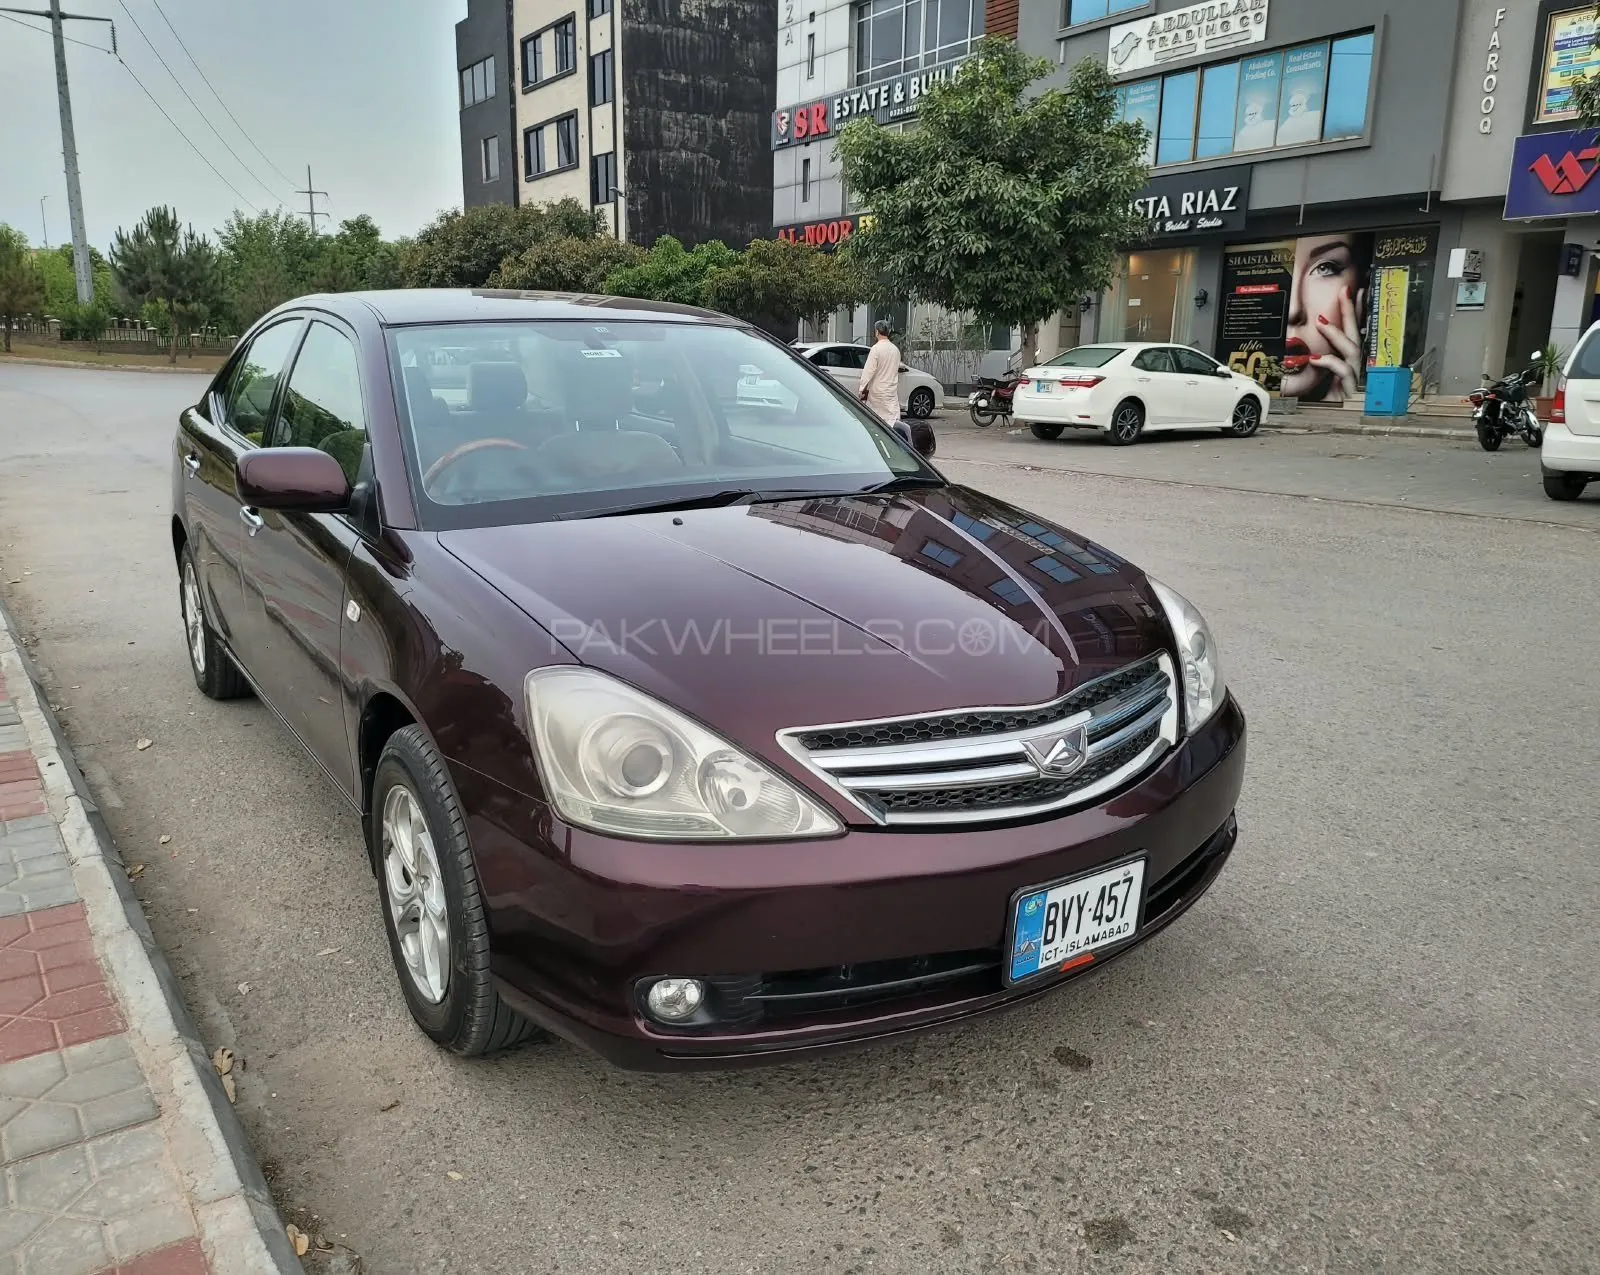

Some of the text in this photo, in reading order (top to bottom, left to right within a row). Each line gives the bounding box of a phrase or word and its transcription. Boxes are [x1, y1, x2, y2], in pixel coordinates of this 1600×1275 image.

[1147, 11, 1265, 50] TRADING CO
[1286, 60, 1322, 73] Consultants
[1303, 50, 1322, 60] Estate
[1479, 8, 1505, 134] FAROOQ
[793, 102, 830, 139] SR
[833, 85, 889, 119] ESTATE
[893, 82, 905, 103] &
[1181, 186, 1239, 215] RIAZ
[1164, 220, 1190, 232] Bridal
[1196, 217, 1223, 228] Studio
[1228, 251, 1296, 266] SHAISTA RIAZ
[1041, 922, 1130, 963] ICT-ISLAMABAD
